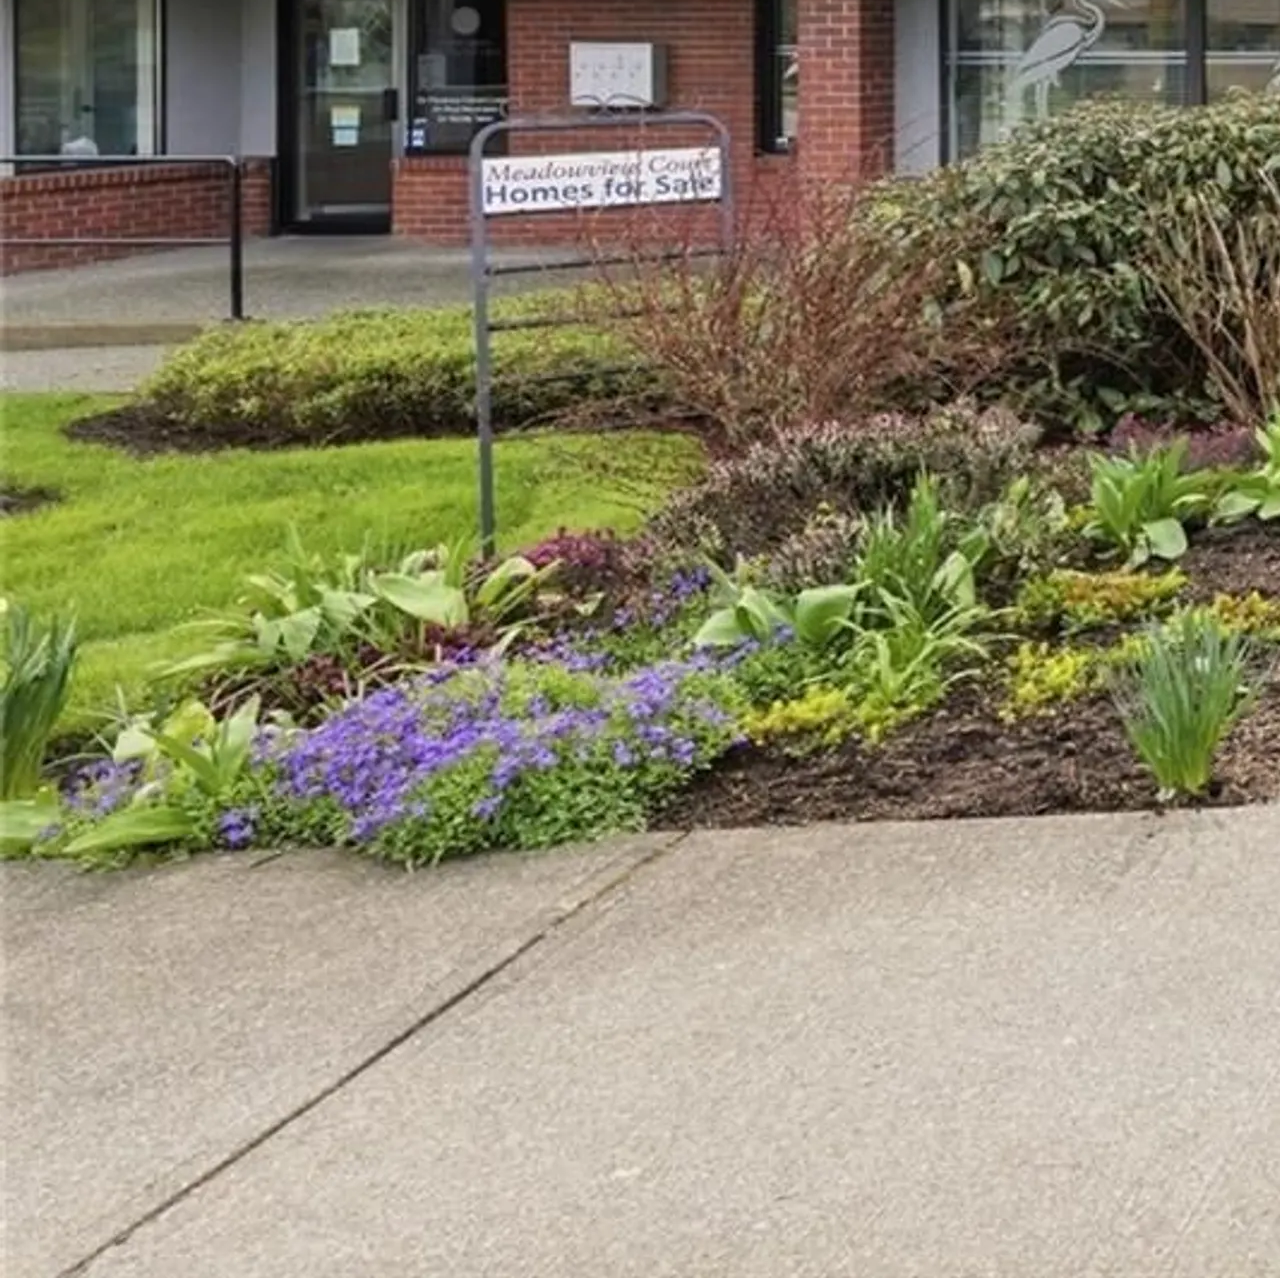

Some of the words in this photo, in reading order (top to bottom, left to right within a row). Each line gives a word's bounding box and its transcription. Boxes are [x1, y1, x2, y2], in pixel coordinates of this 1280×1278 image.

[485, 181, 594, 205] Homes
[604, 177, 646, 199] for
[655, 172, 714, 197] Sale
